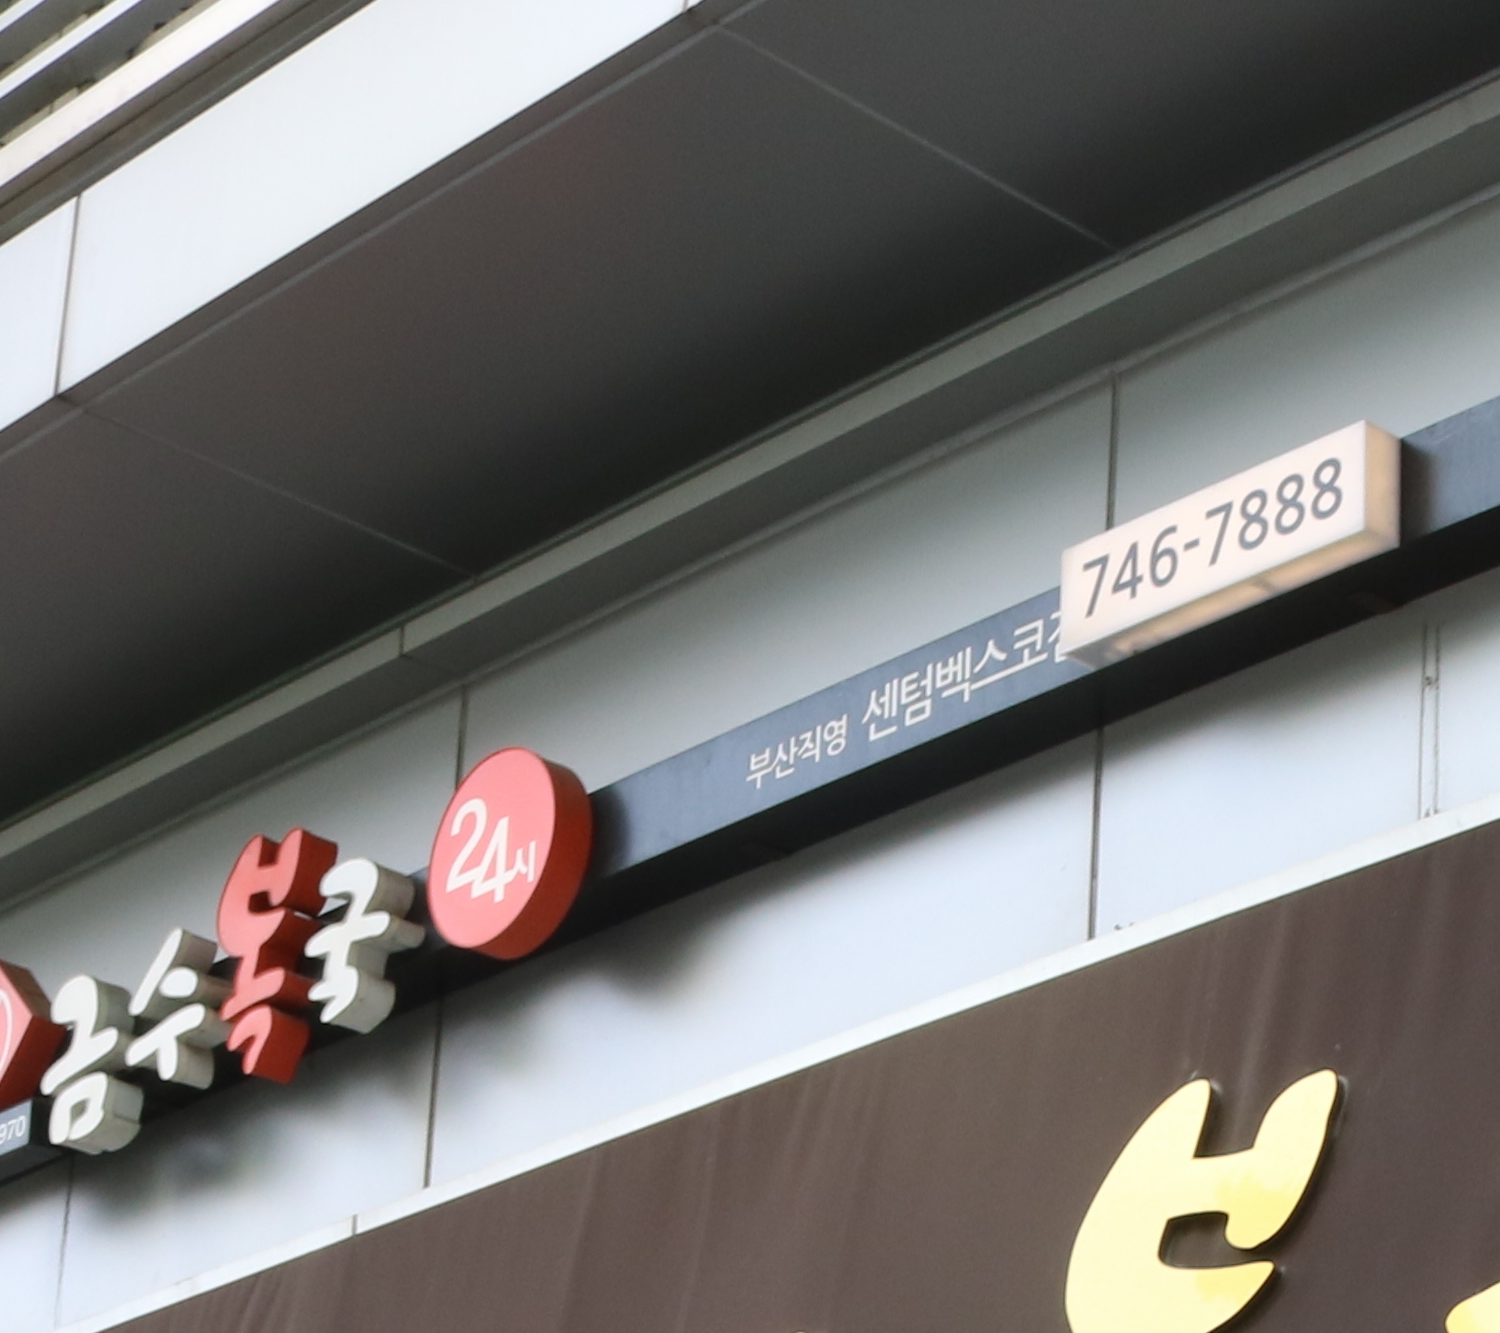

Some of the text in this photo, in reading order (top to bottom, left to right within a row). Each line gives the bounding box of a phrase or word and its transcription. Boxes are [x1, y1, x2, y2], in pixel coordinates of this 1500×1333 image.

[1081, 456, 1343, 618] 746-7888
[745, 713, 848, 790] 부산직영
[446, 798, 536, 902] 24시
[40, 828, 390, 1144] 금수복국
